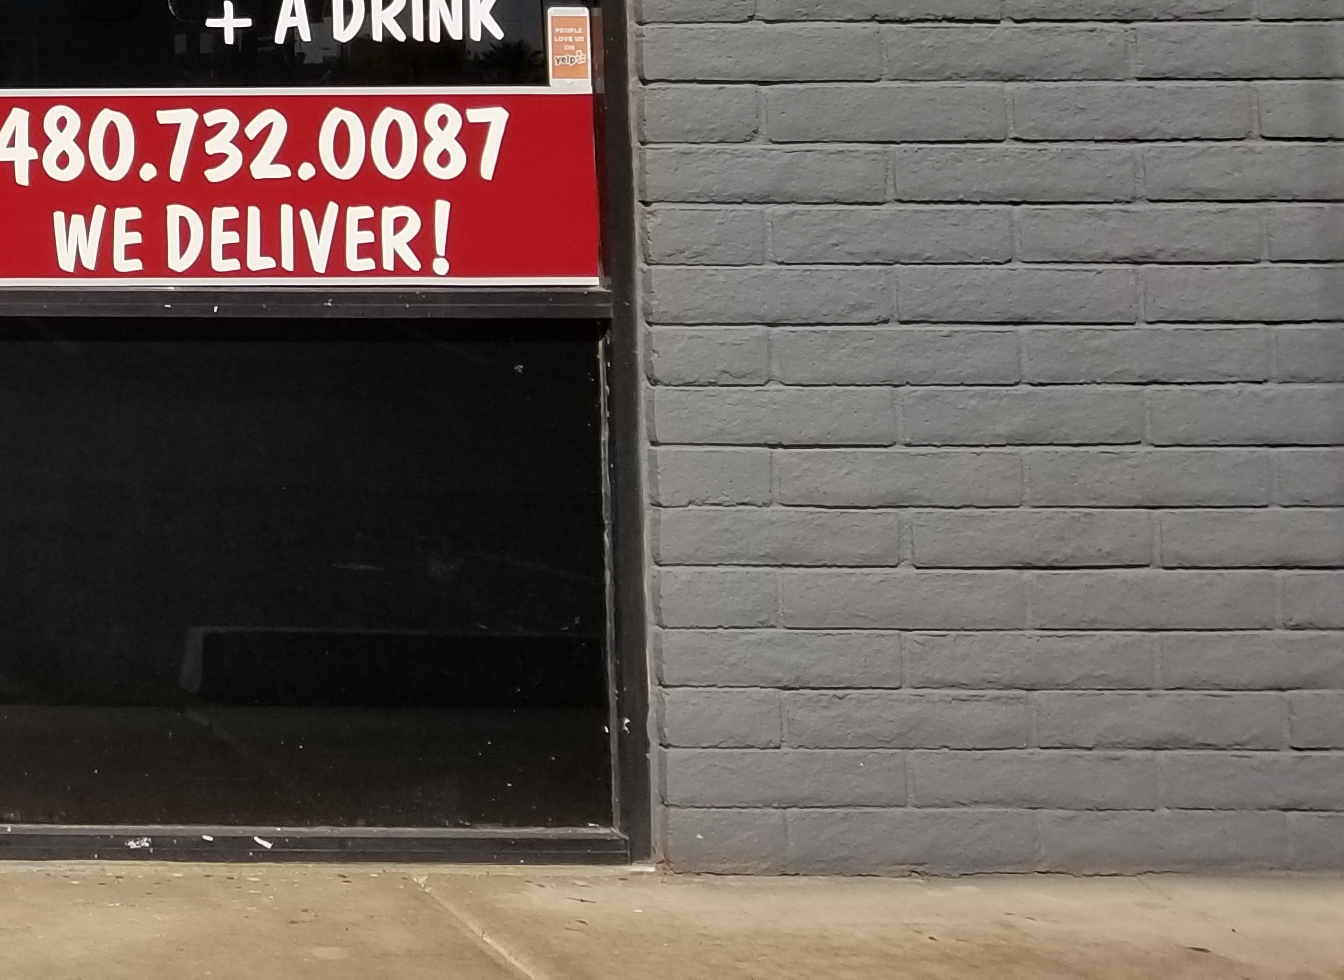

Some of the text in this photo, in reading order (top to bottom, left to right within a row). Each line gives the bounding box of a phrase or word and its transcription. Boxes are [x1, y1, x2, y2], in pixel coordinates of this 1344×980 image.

[205, 0, 252, 45] +
[555, 55, 576, 66] yelp
[53, 199, 451, 277] WE DELIVER!
